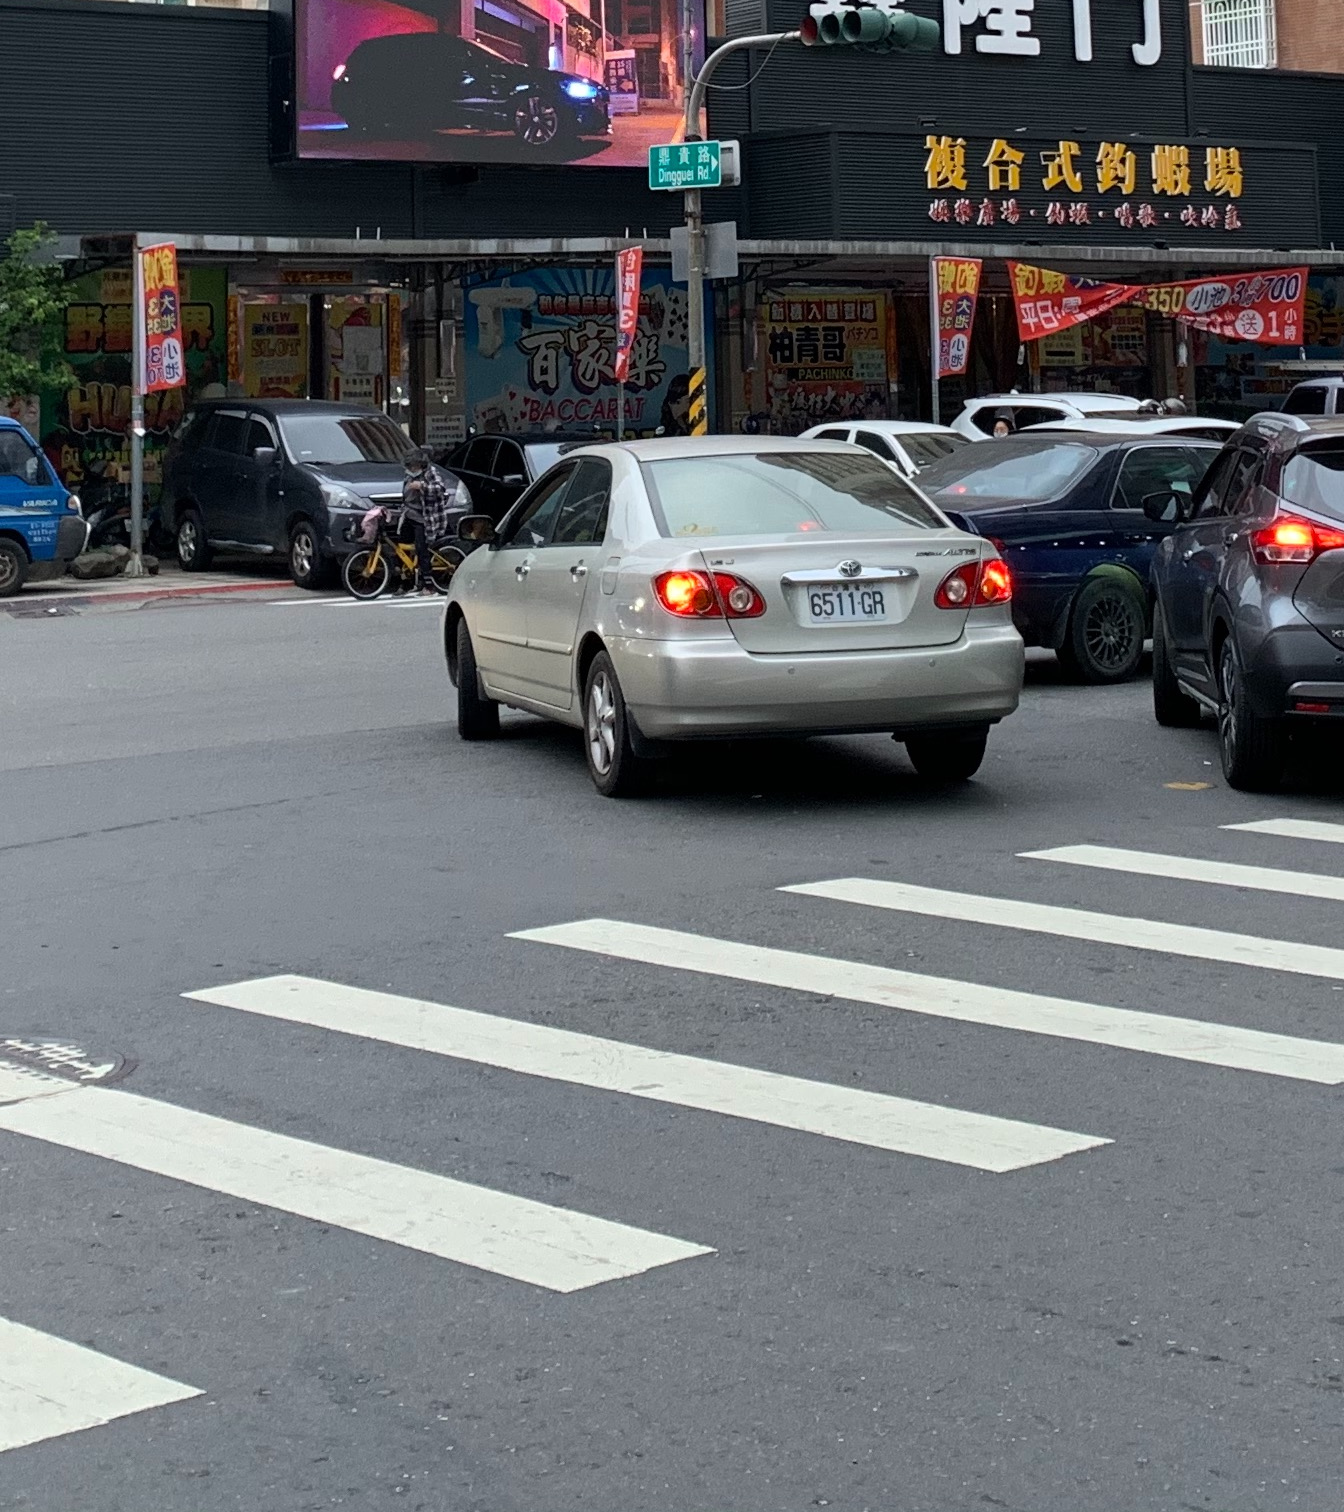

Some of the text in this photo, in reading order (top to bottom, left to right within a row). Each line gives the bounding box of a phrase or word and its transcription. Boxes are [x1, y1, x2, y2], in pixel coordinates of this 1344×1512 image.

[658, 145, 710, 166] 鼎貴路
[924, 134, 1244, 198] 複合式釣蝦場
[659, 165, 711, 185] Dingguei Rd.
[1014, 262, 1066, 297] 釣蝦
[1146, 287, 1185, 313] 350
[1191, 285, 1227, 311] 小池
[528, 397, 645, 423] BACCARAT
